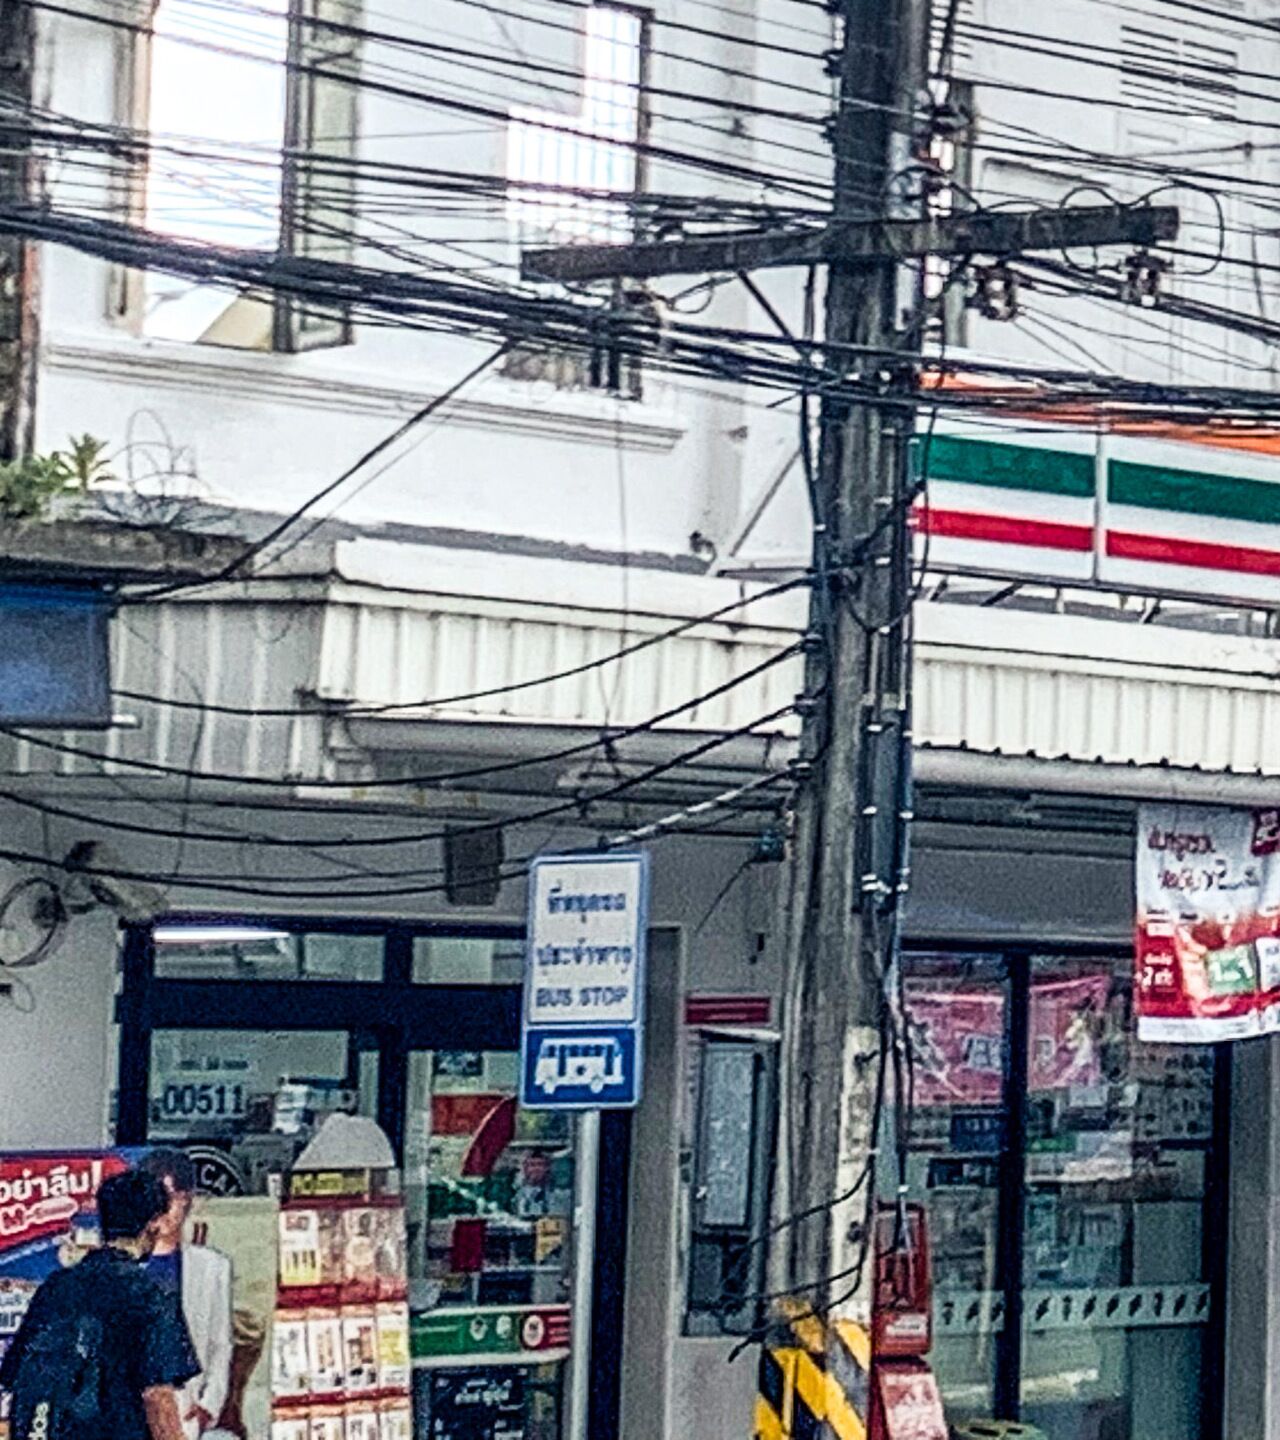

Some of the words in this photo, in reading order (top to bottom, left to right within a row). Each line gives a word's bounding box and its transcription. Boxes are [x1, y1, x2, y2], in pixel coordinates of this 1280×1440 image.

[536, 987, 572, 1007] BUS
[579, 986, 628, 1007] STOP
[163, 1084, 244, 1114] 00511
